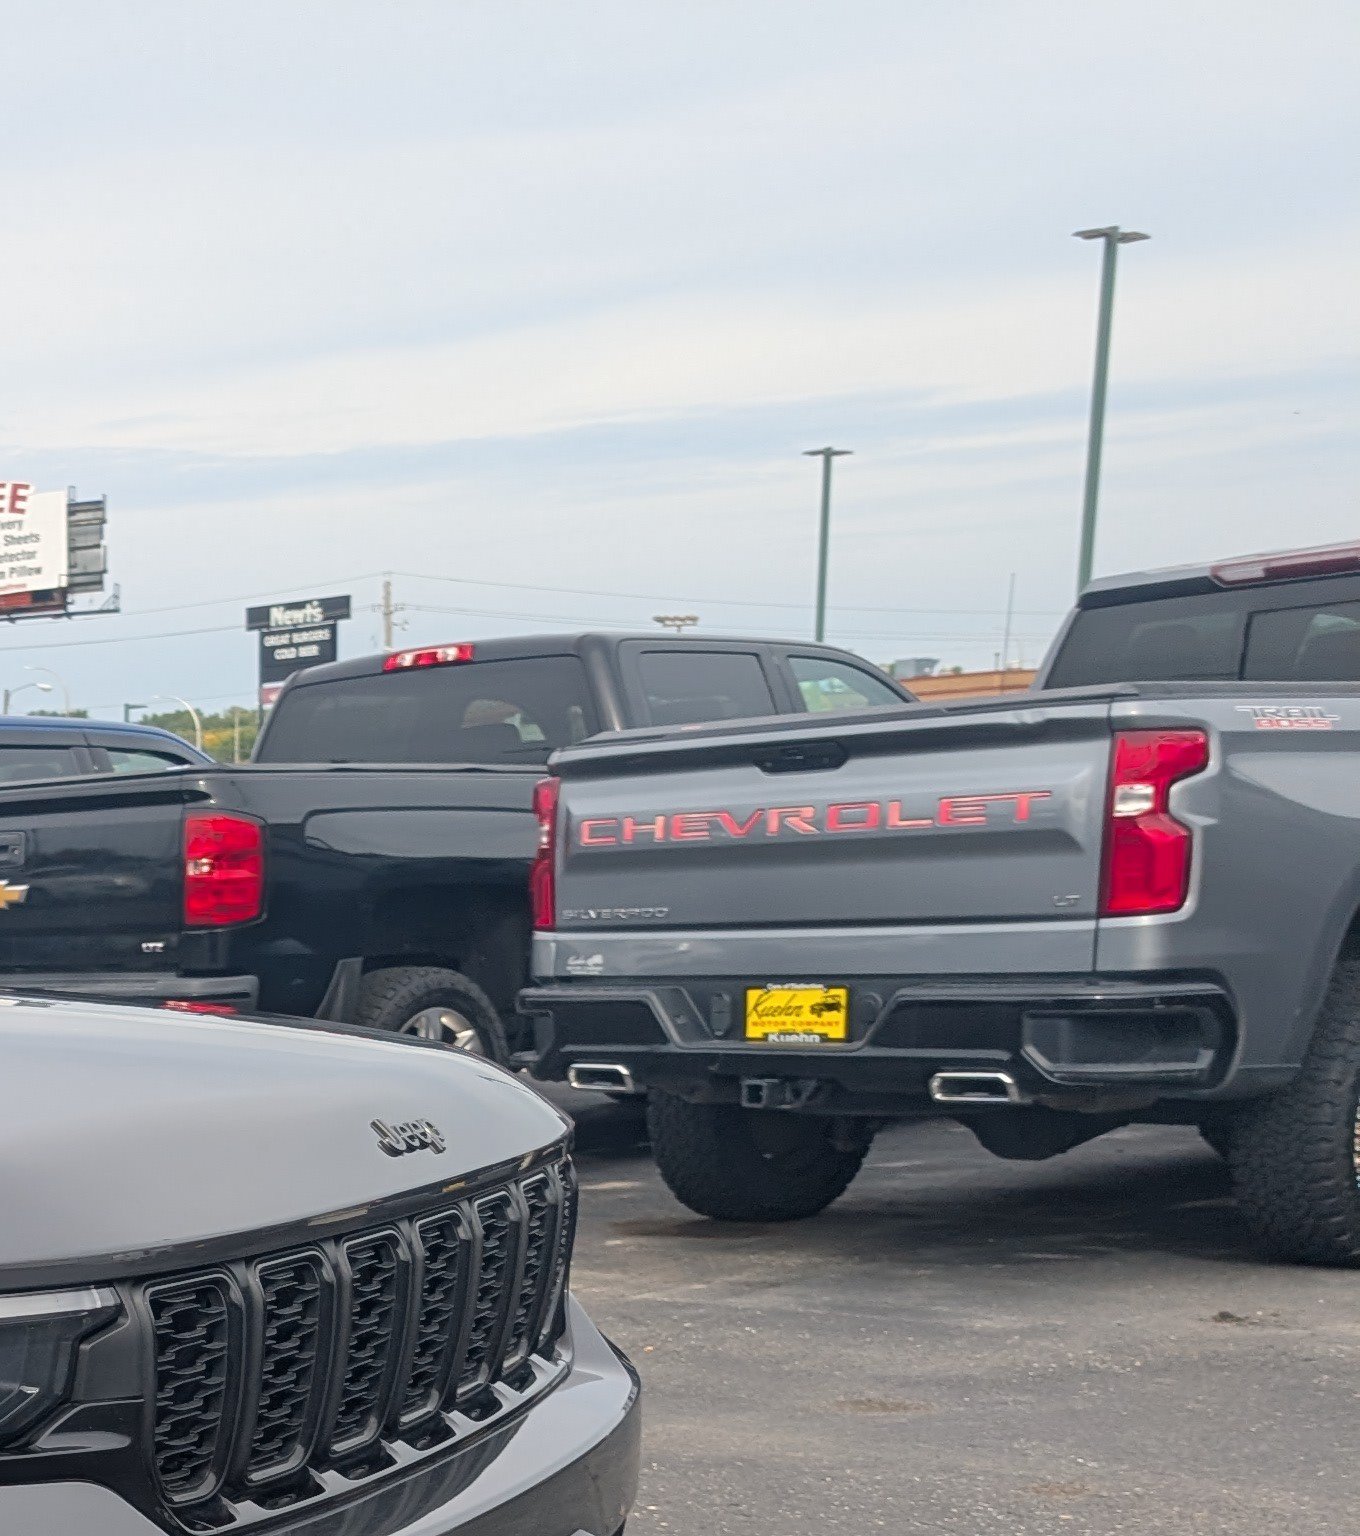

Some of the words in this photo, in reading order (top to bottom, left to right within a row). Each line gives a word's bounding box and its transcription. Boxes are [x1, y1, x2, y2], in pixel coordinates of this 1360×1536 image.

[4, 533, 40, 546] Sheets
[9, 566, 42, 578] Pillow
[1255, 719, 1332, 730] BOSS
[579, 790, 1053, 847] CHEVROLET
[560, 907, 669, 920] SILVERADO
[747, 993, 804, 1020] Kuehn
[767, 1032, 821, 1043] Kuehn
[370, 1118, 447, 1158] Jeep
